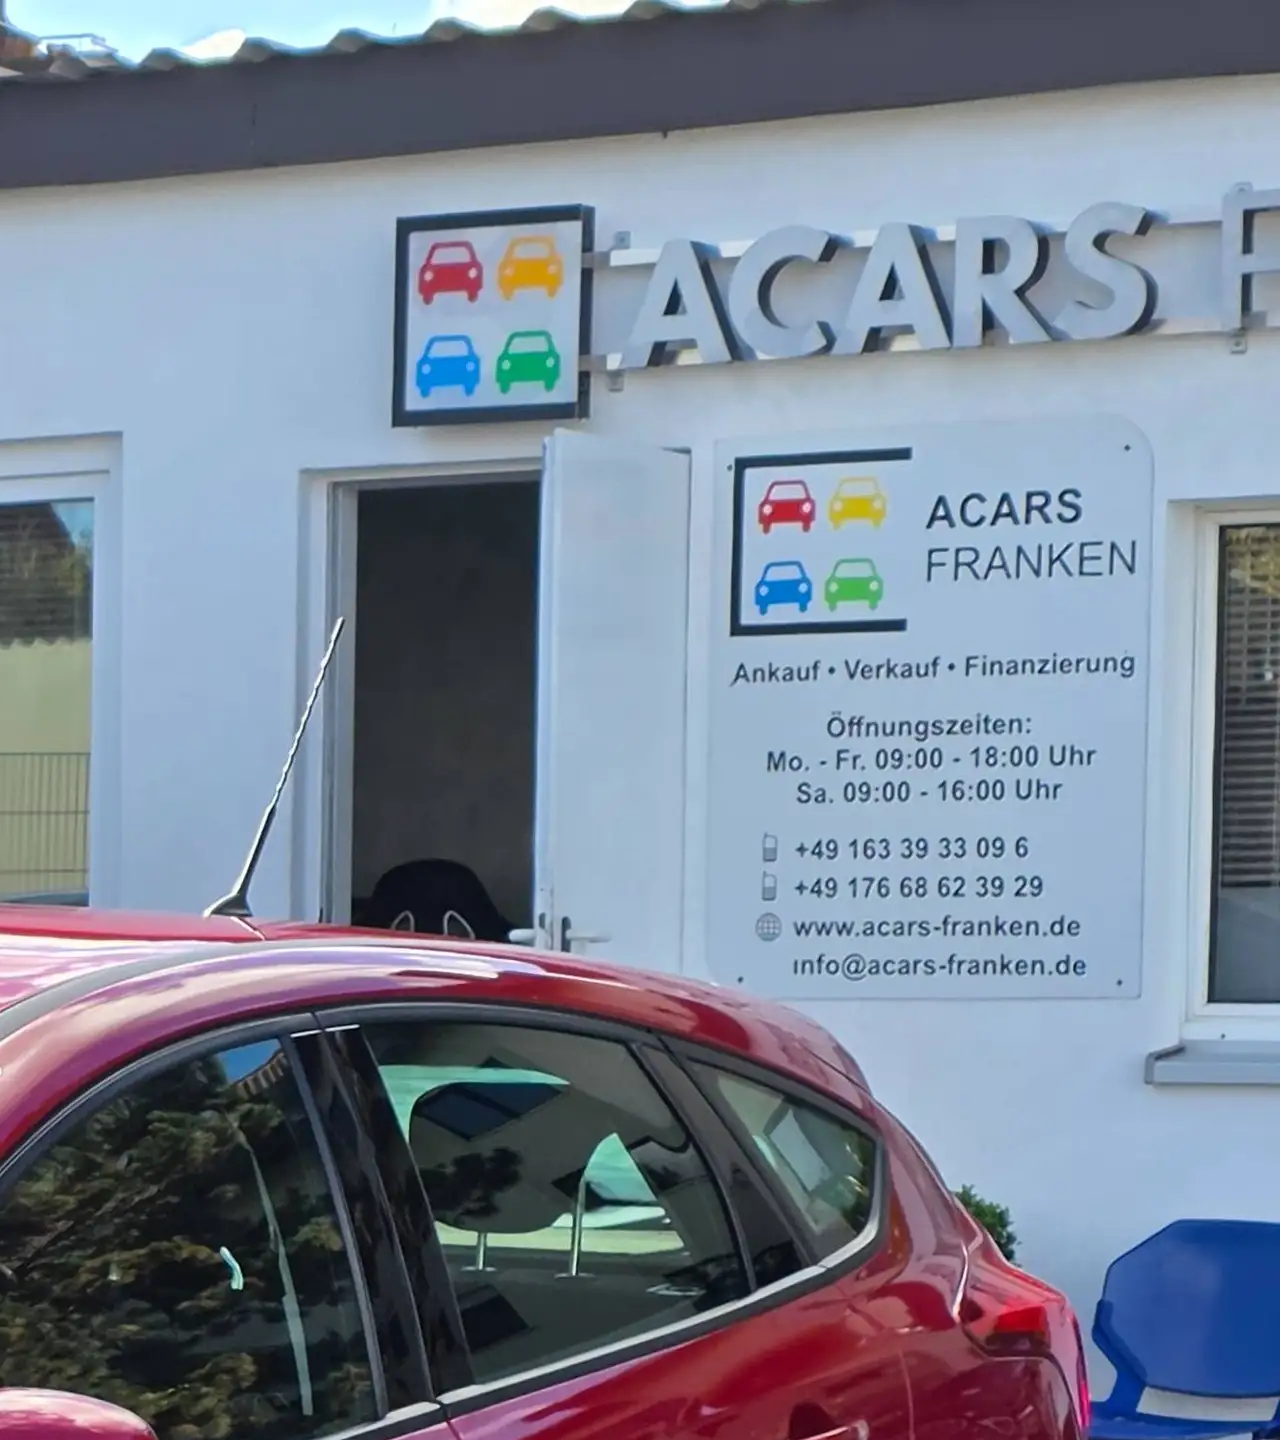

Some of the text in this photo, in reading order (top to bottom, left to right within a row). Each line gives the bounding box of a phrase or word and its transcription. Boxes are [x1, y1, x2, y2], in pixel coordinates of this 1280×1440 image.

[620, 203, 1158, 370] ACARS
[925, 488, 1082, 530] ACARS
[926, 539, 1137, 583] FRANKEN
[729, 659, 821, 687] Ankauf
[844, 655, 941, 681] Verkauf
[964, 652, 1135, 679] Finanzierung
[826, 711, 1032, 743] Öffnungszeiten:
[766, 750, 810, 773] Mo.
[835, 748, 866, 771] Fr.
[875, 746, 943, 771] 09:00
[969, 744, 1039, 769] 18:00
[1049, 744, 1098, 767] Uhr
[796, 781, 834, 805] Sa.
[843, 780, 911, 804] 09:00
[937, 778, 1006, 802] 16:00
[1015, 778, 1063, 801] Uhr
[795, 835, 1029, 861] +49 163 39 33 09 6
[794, 875, 1044, 899] +49 176 68 62 39 29
[793, 914, 1081, 938] www.acars-franken.de
[793, 953, 1087, 982] info@acars-franken.de
